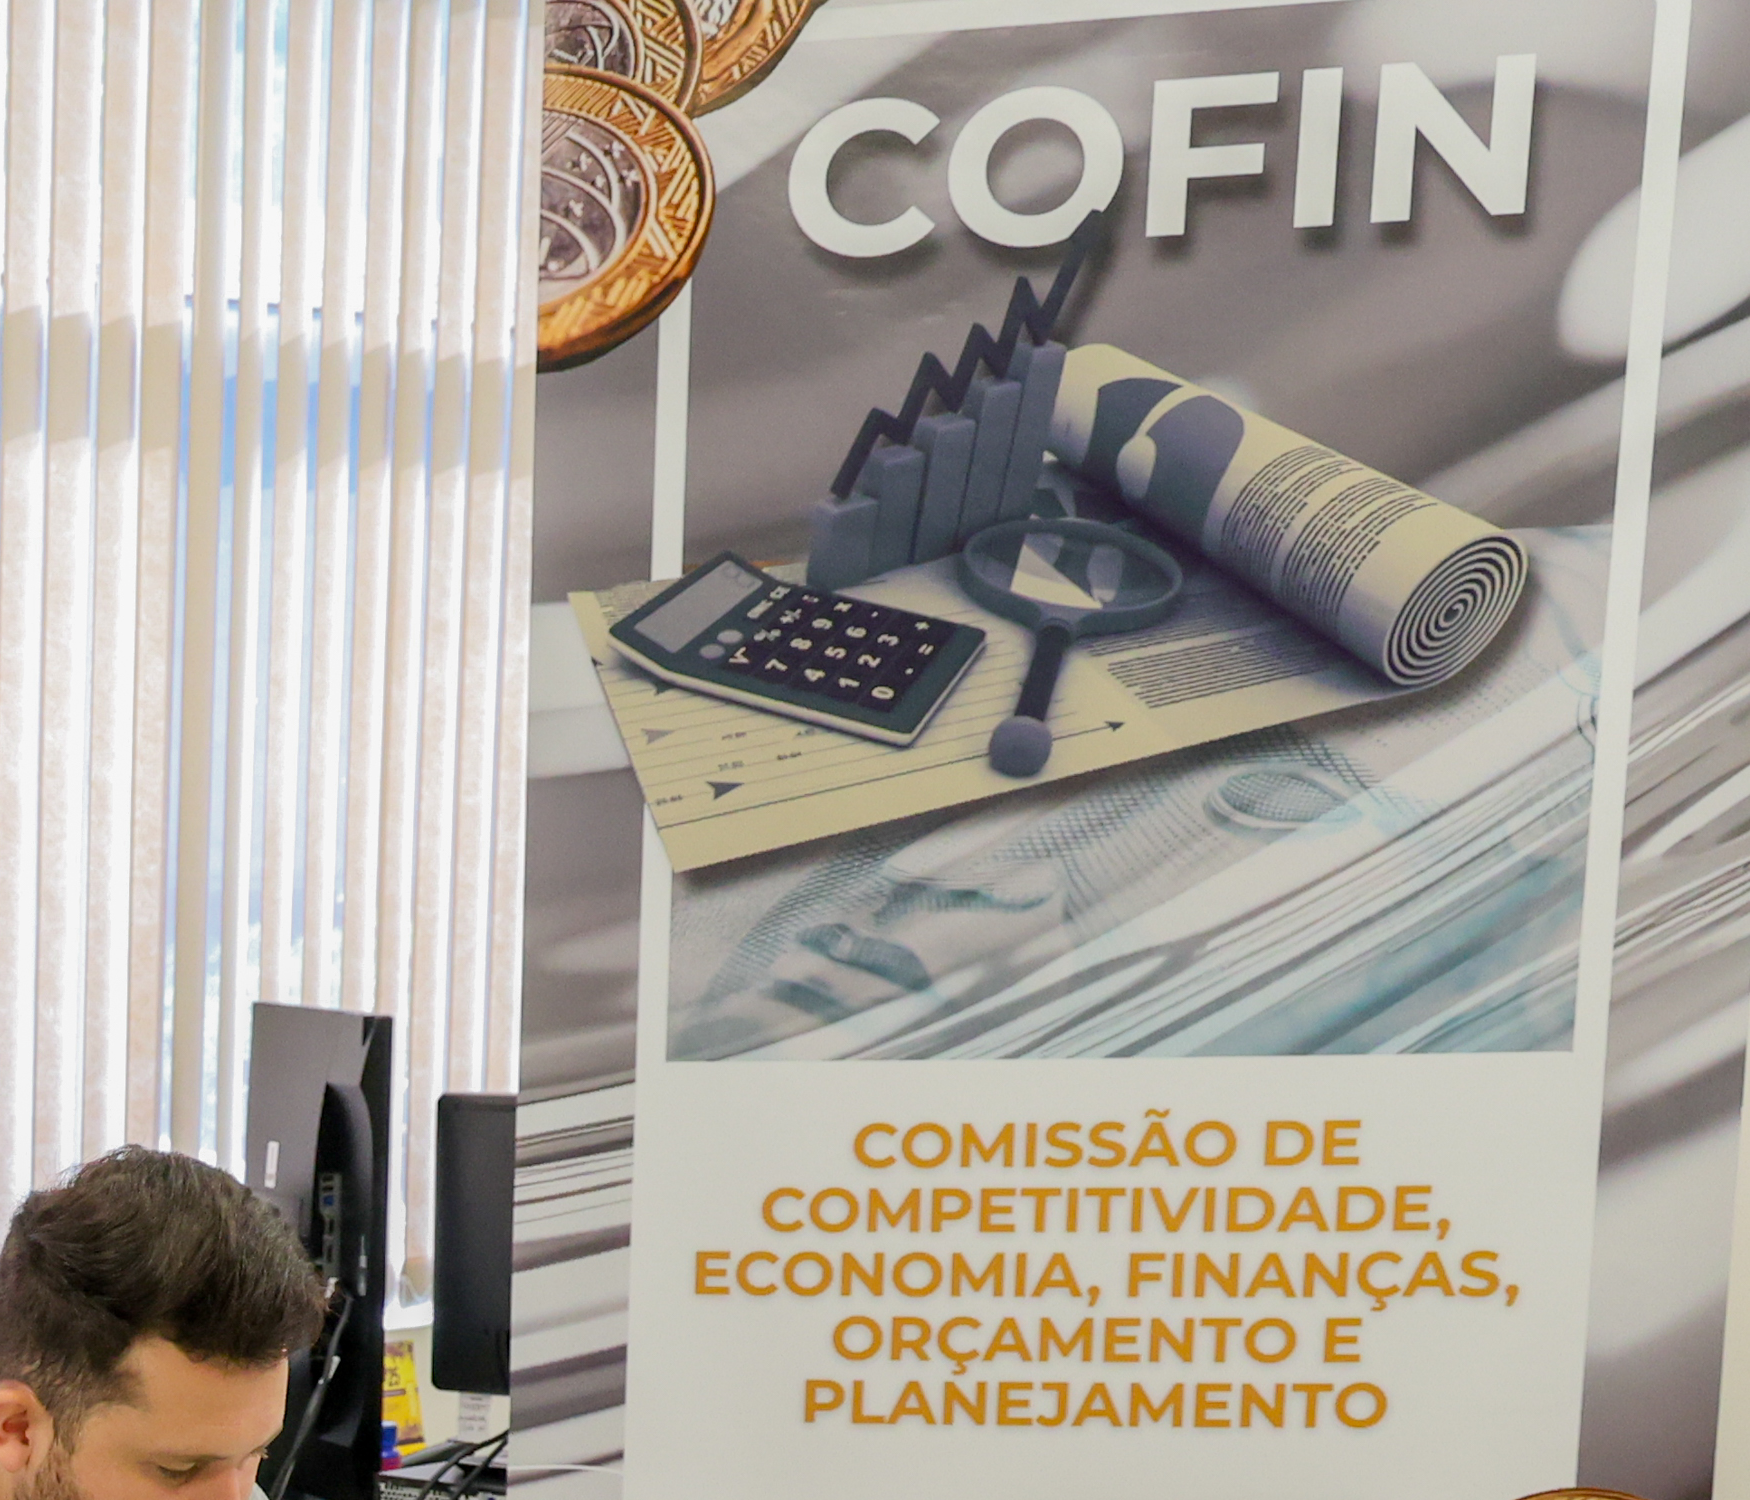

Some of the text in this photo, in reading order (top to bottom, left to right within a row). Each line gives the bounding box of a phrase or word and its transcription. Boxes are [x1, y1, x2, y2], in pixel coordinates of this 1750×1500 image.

[786, 53, 1538, 260] COFIN
[854, 1109, 1363, 1171] COMISSÃO DE
[762, 1185, 1453, 1242] COMPETITIVIDADE,
[695, 1250, 1522, 1313] ECONOMIA, FINANÇAS,
[833, 1315, 1365, 1377] ORÇAMENTO E
[805, 1379, 1390, 1430] PLANEJAMENTO
